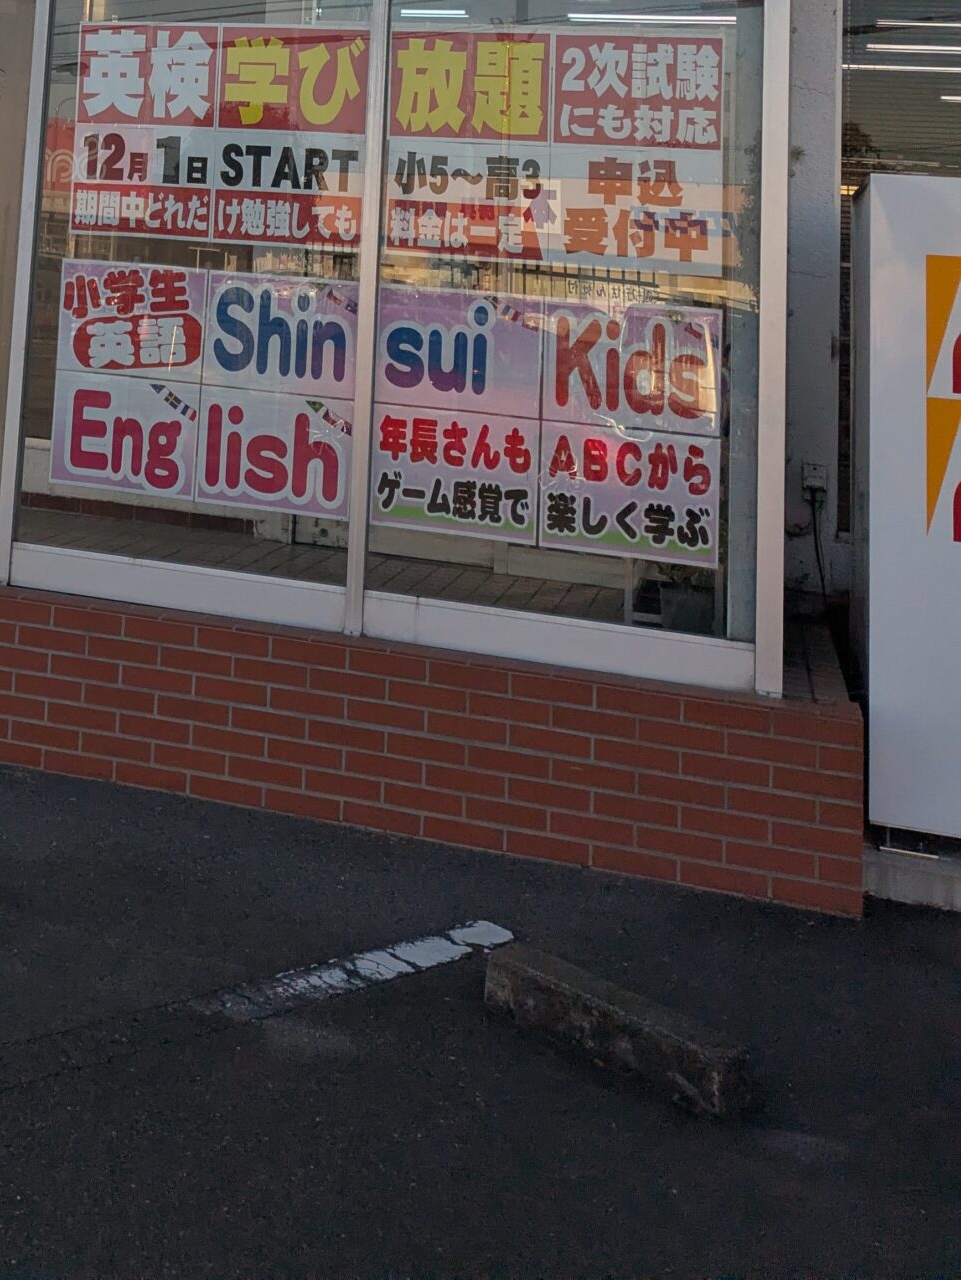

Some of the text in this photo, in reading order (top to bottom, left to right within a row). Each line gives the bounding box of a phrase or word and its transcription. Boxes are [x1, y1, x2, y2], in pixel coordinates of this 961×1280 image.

[561, 42, 720, 100] 2次試験
[560, 104, 717, 144] にも対応
[220, 144, 359, 193] START
[587, 156, 684, 208] 申込
[564, 207, 710, 263] 受付中
[64, 269, 190, 319] 小学生
[88, 320, 187, 368] 英語
[555, 314, 711, 420] Kids
